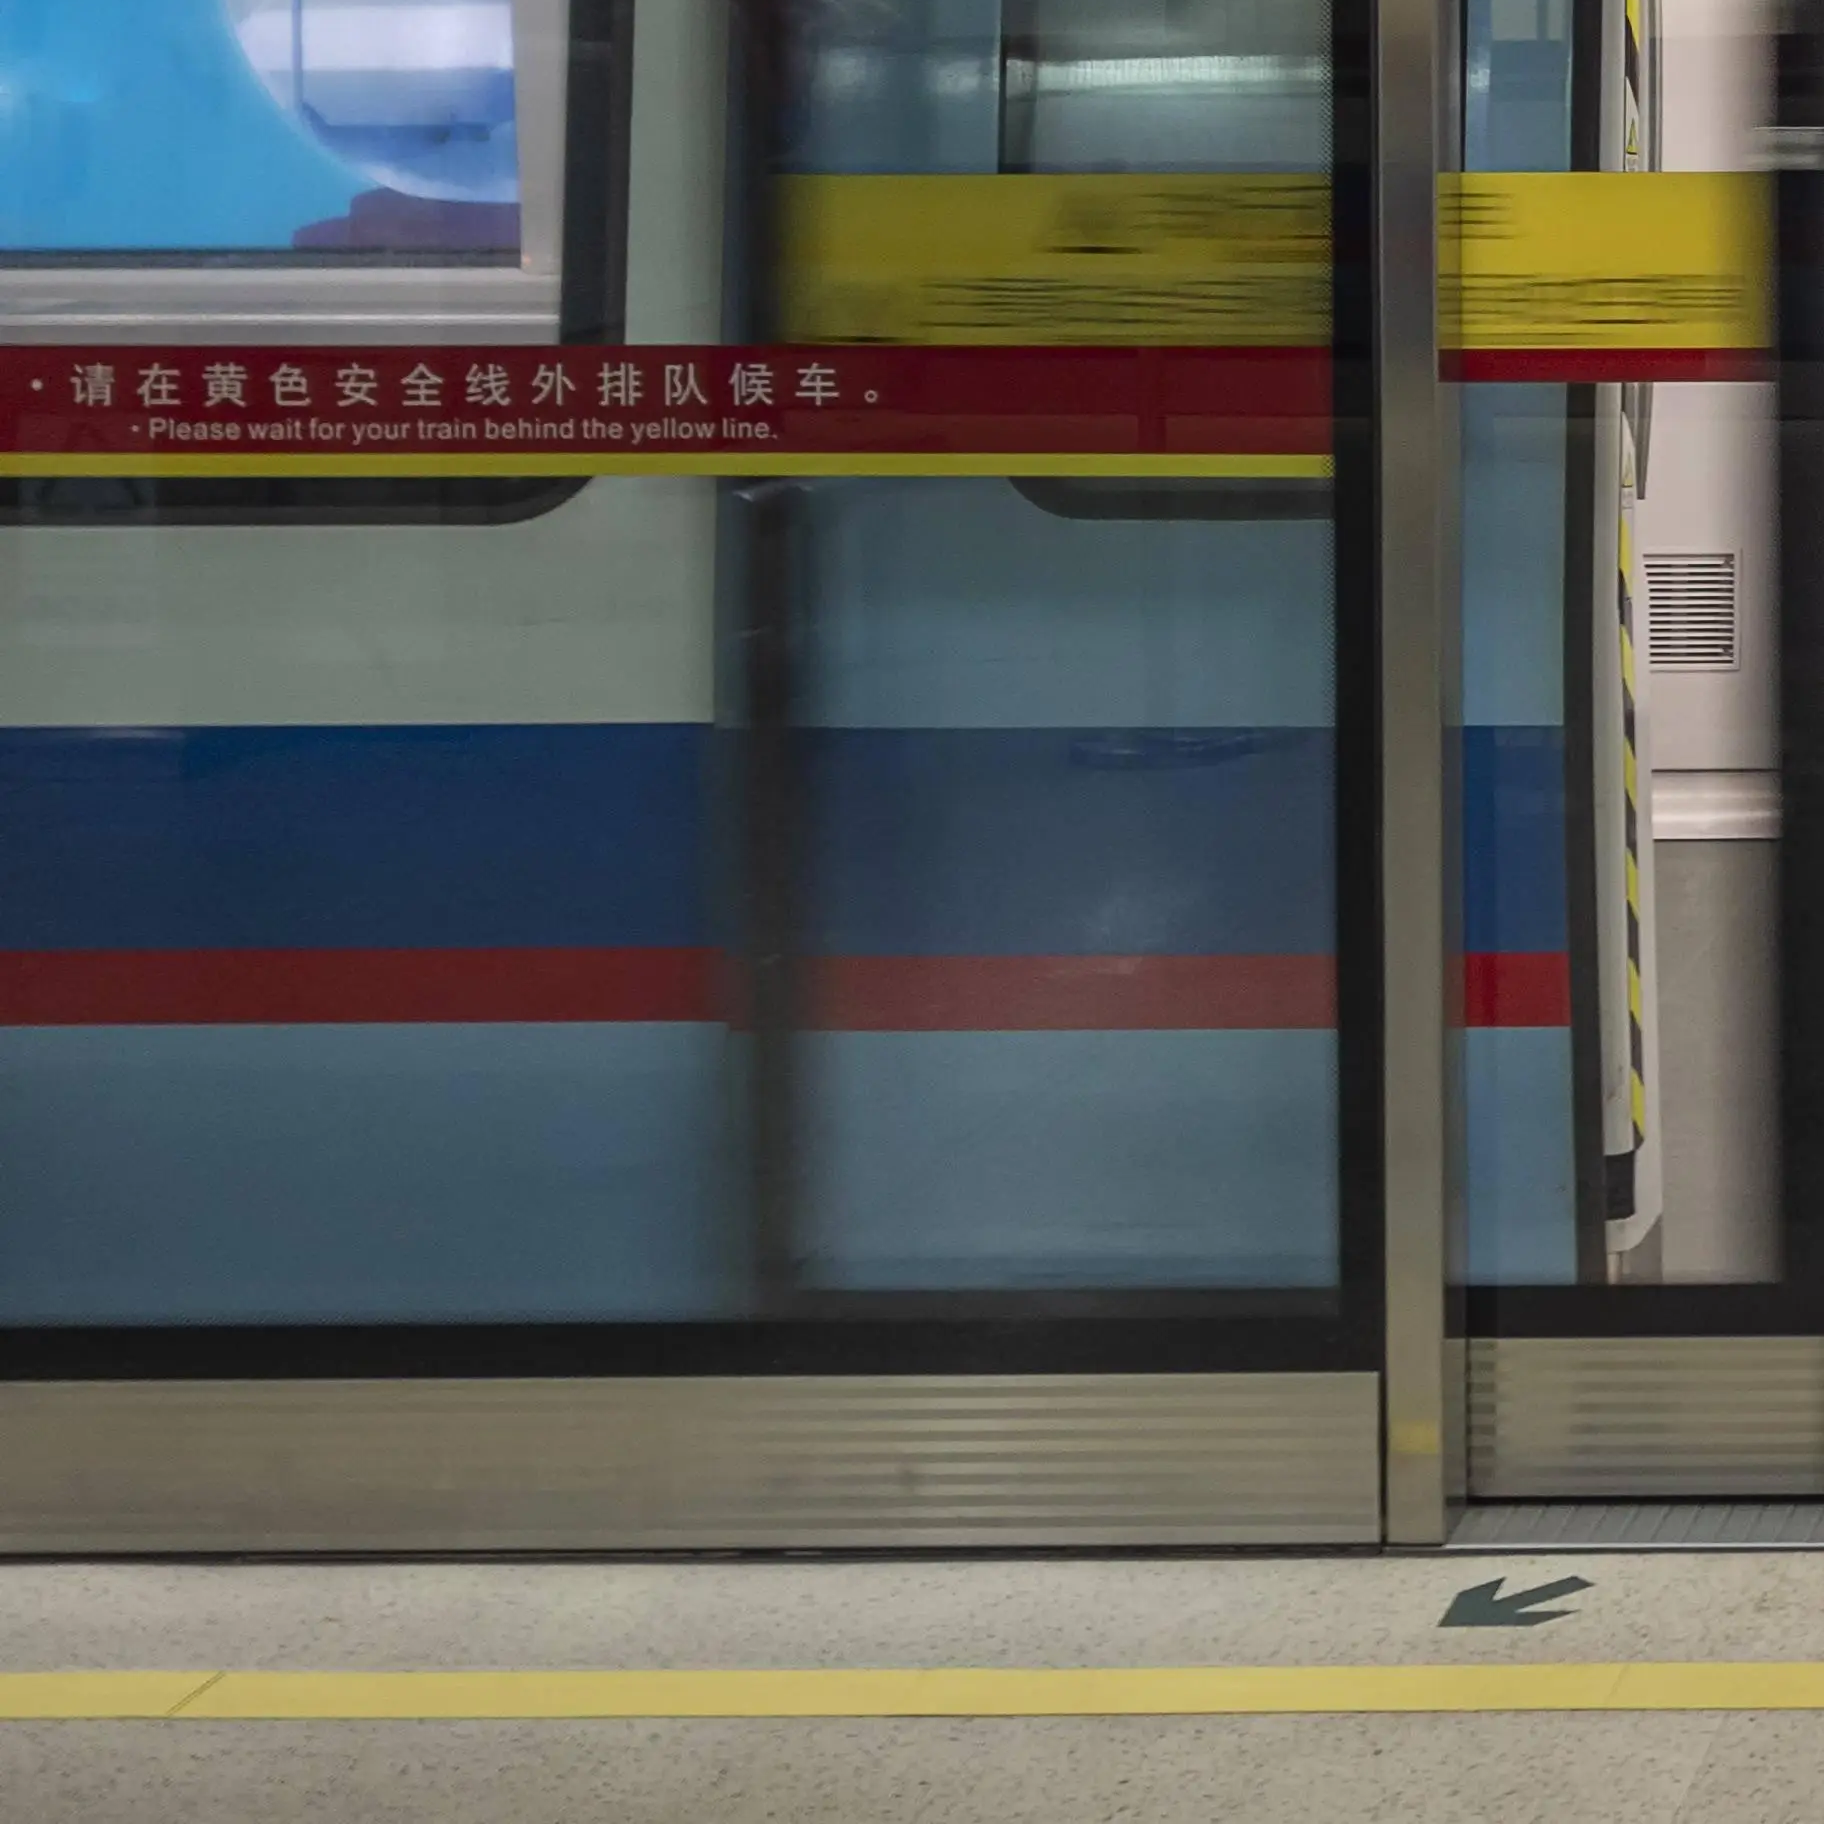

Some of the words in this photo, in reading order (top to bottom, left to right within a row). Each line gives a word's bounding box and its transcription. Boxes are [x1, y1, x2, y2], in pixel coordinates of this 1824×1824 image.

[70, 362, 879, 407] 请在黄色安全线外排队候车。
[148, 418, 241, 441] Please
[248, 418, 303, 440] wait
[309, 418, 345, 440] for
[350, 423, 411, 446] your
[417, 418, 477, 440] train
[484, 418, 574, 439] behind
[582, 418, 623, 439] the
[630, 418, 717, 445] yellow
[723, 418, 778, 439] line.
